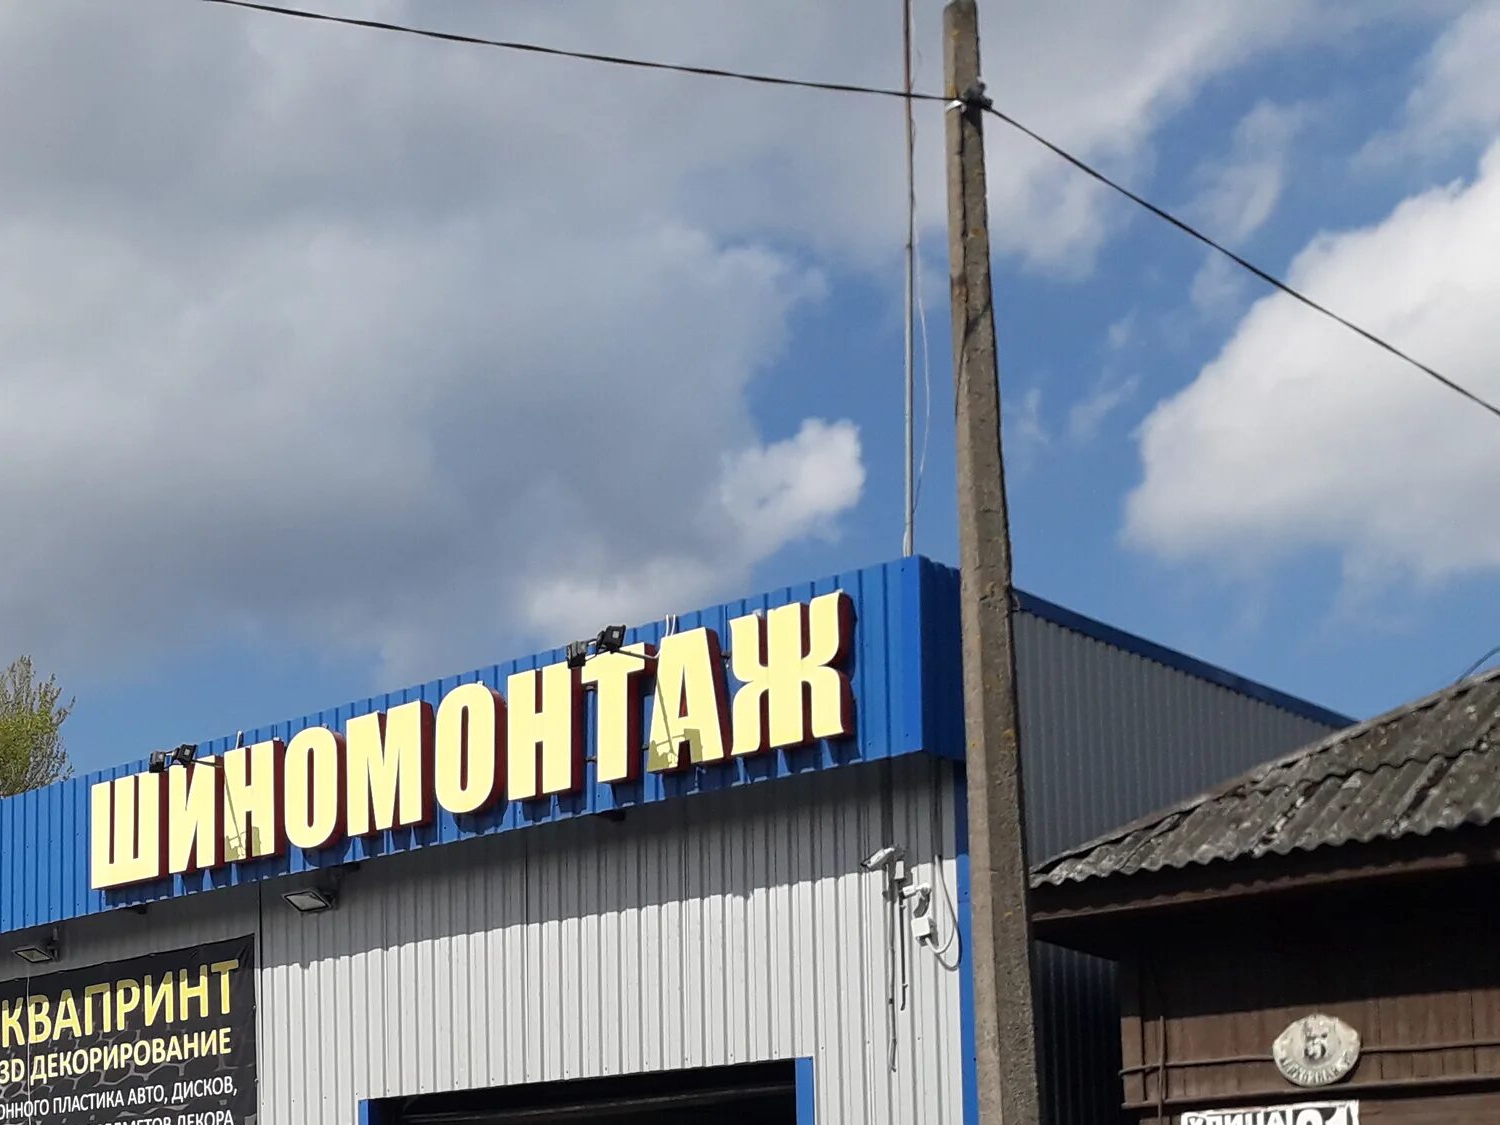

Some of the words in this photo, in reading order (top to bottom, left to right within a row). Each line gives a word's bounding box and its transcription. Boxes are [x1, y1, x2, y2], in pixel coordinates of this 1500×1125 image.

[92, 591, 847, 889] ШИНОМОНТАЖ
[30, 1027, 232, 1085] ДЕКОРИРОВАНИЕ
[53, 1090, 125, 1115] ПЛАСТИКА
[127, 1084, 169, 1106] АВТО,
[171, 1076, 238, 1103] ДИСКОВ,
